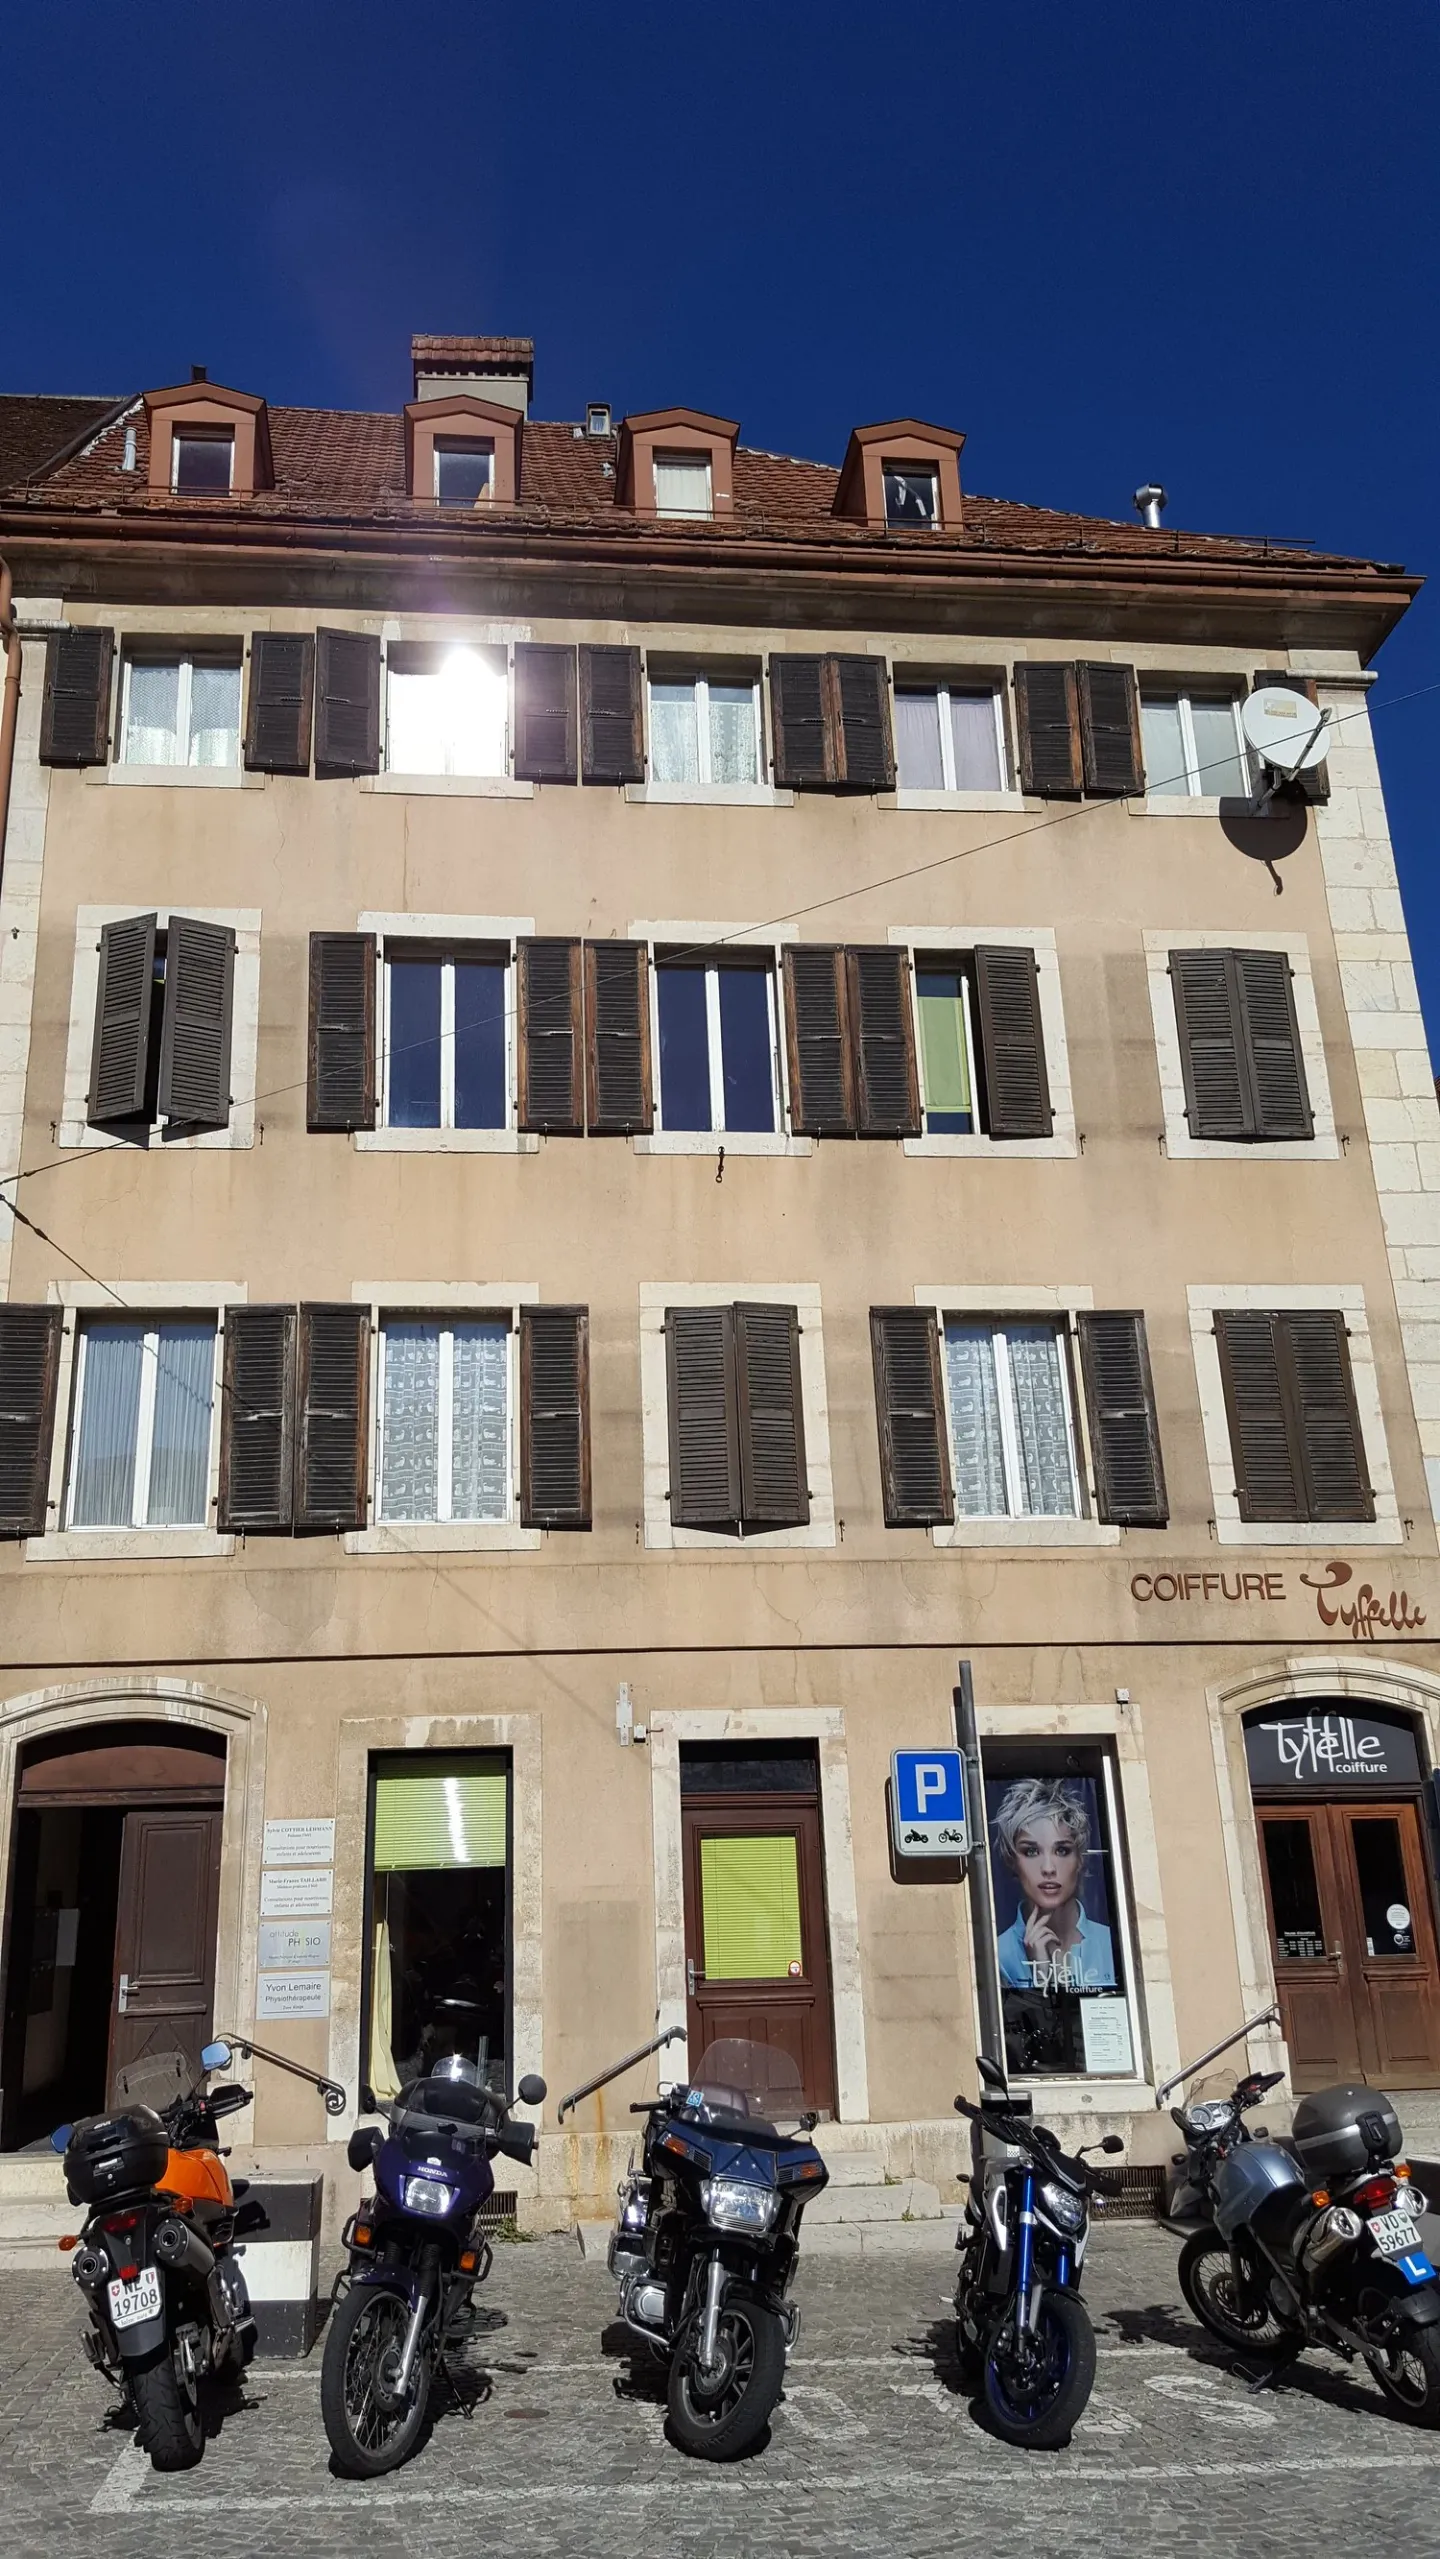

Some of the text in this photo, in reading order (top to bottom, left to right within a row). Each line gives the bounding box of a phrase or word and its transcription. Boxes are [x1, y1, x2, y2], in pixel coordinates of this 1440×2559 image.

[1131, 1573, 1287, 1601] COIFFURE
[1335, 1761, 1388, 1773] coiffure
[915, 1763, 946, 1814] P
[288, 1936, 321, 1947] PHSIO
[266, 1982, 322, 1992] Yvon Lemaire
[1069, 1986, 1103, 1994] coiffure
[417, 2165, 448, 2178] HONDA
[1380, 2214, 1399, 2232] VD
[1378, 2227, 1417, 2251] 59677
[1405, 2256, 1427, 2277] L
[114, 2288, 158, 2317] 19708
